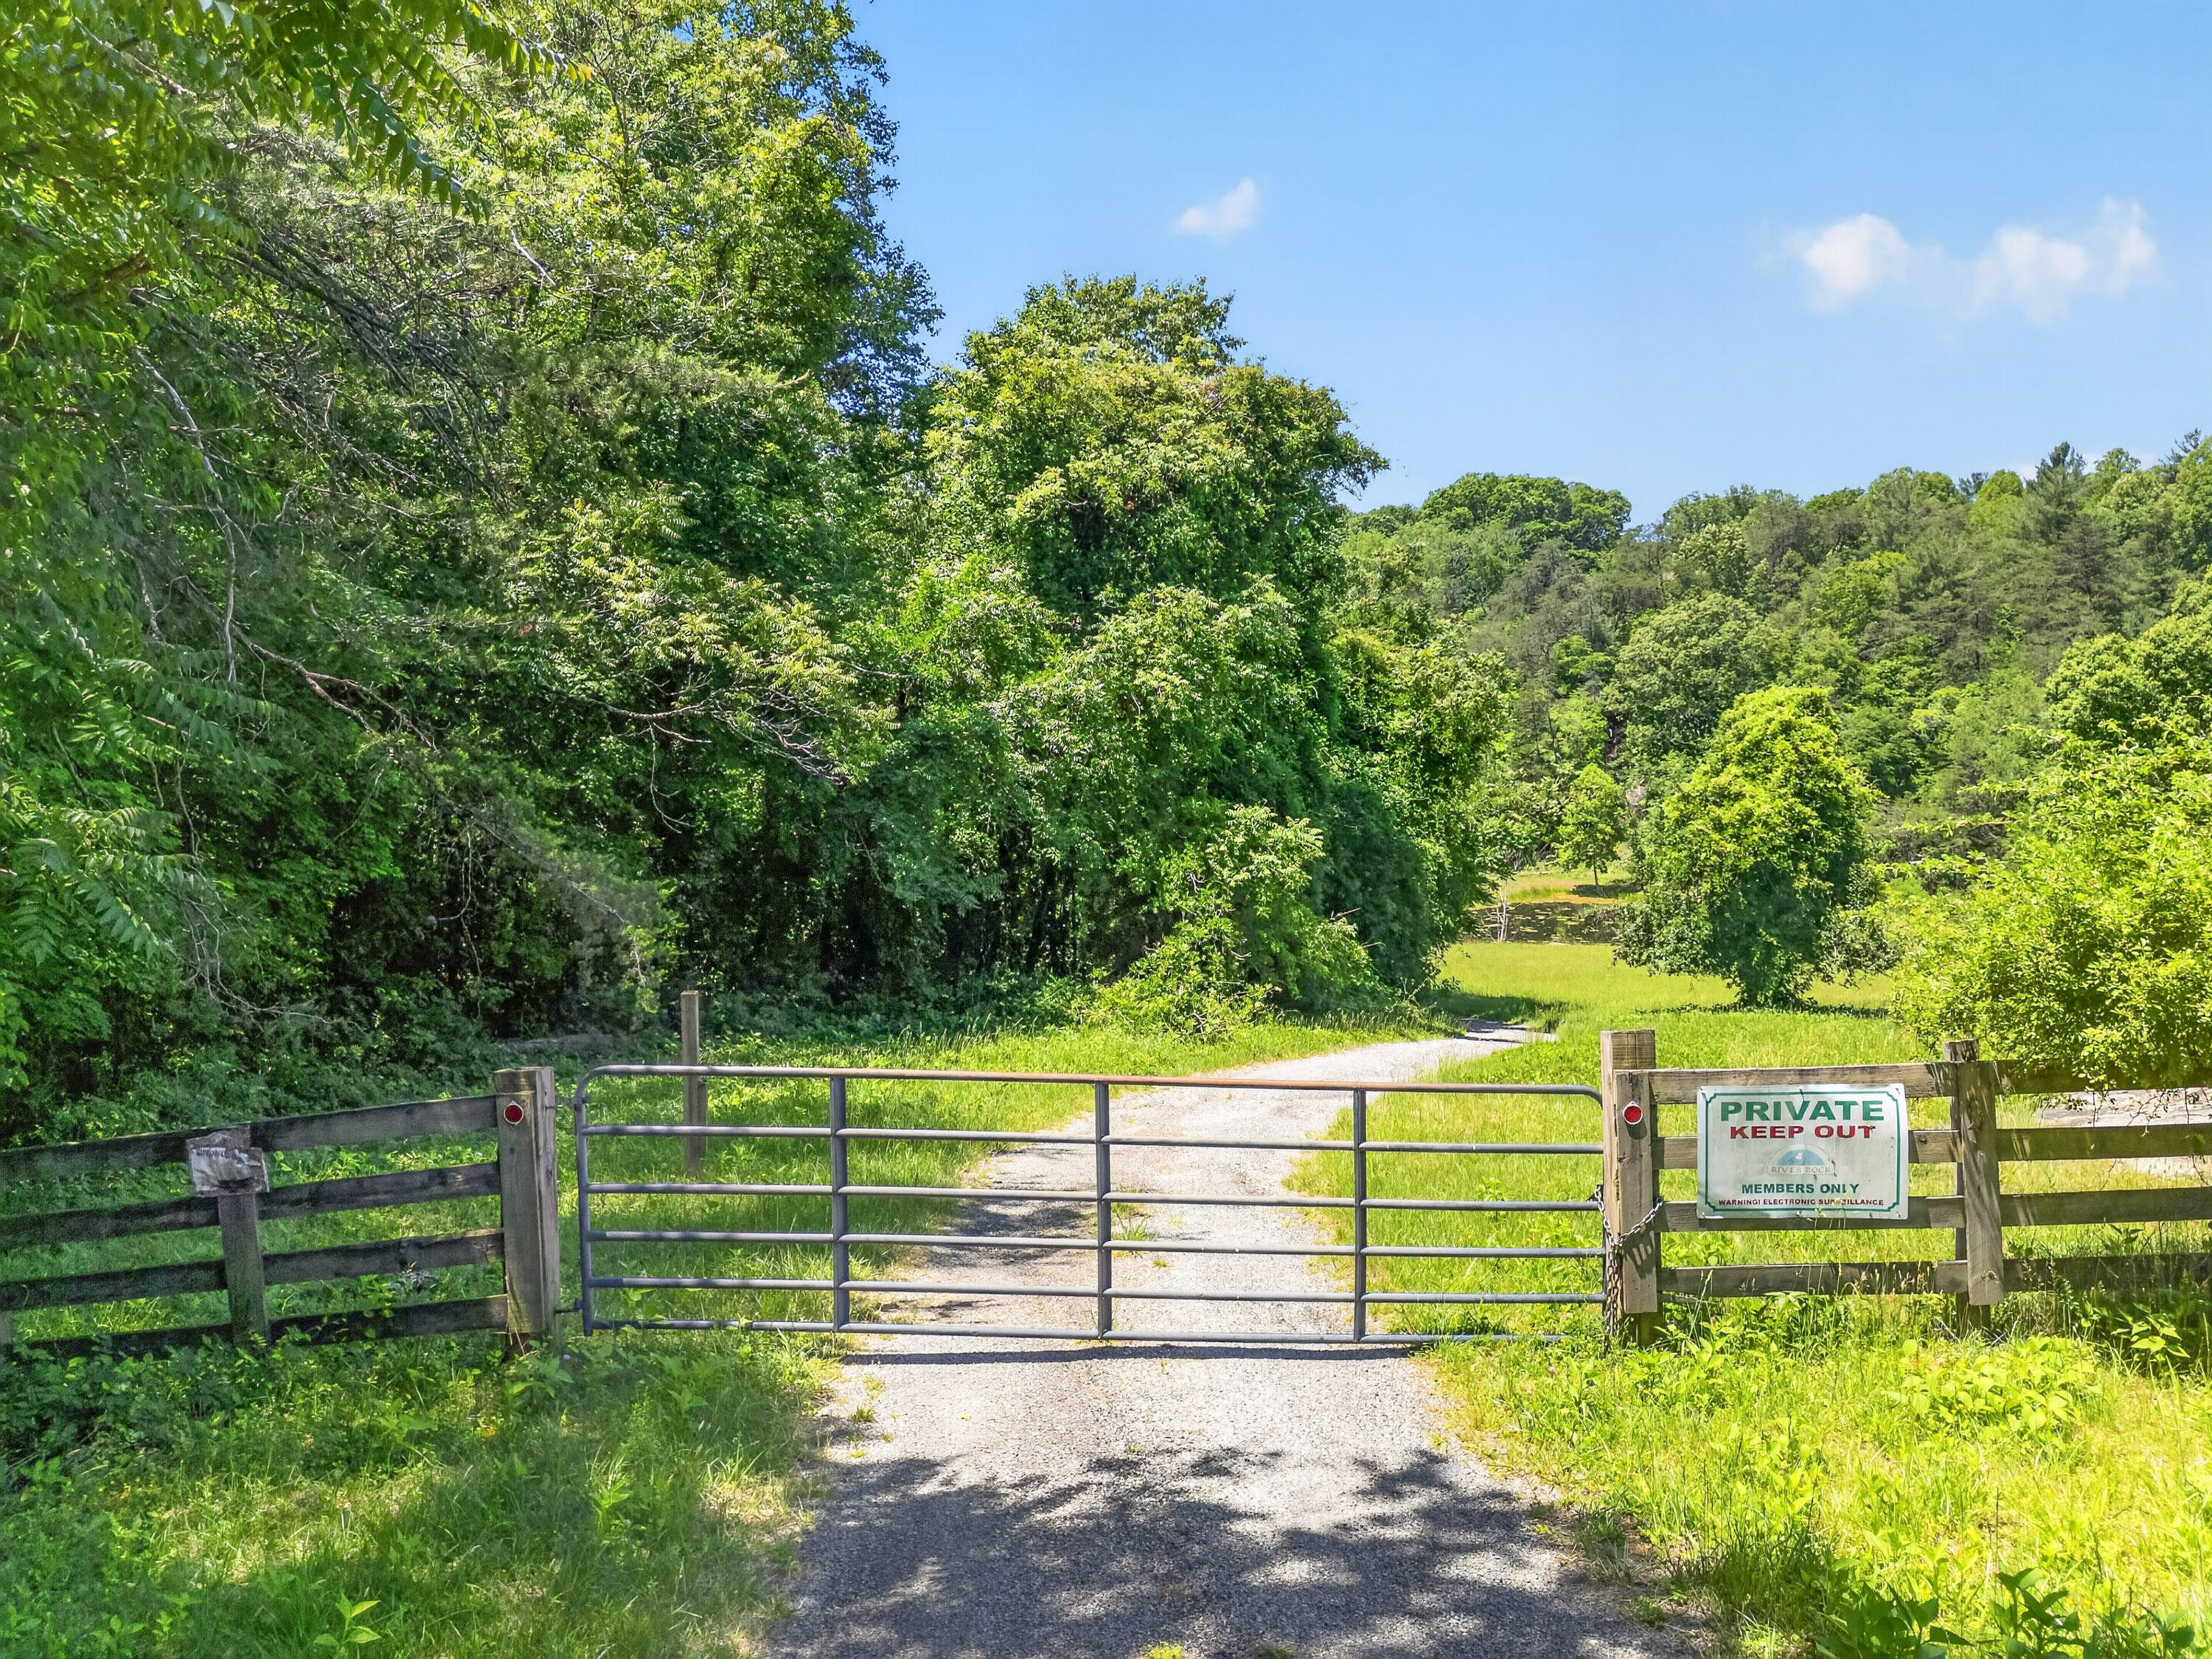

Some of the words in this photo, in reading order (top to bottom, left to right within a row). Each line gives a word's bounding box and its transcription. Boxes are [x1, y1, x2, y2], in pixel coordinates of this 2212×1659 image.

[1720, 1100, 1885, 1121] PRIVATE
[1730, 1125, 1804, 1139] KEEP
[1814, 1125, 1875, 1138] OUT
[1742, 1183, 1815, 1194] MEMBERS
[1820, 1183, 1860, 1194] ONLY
